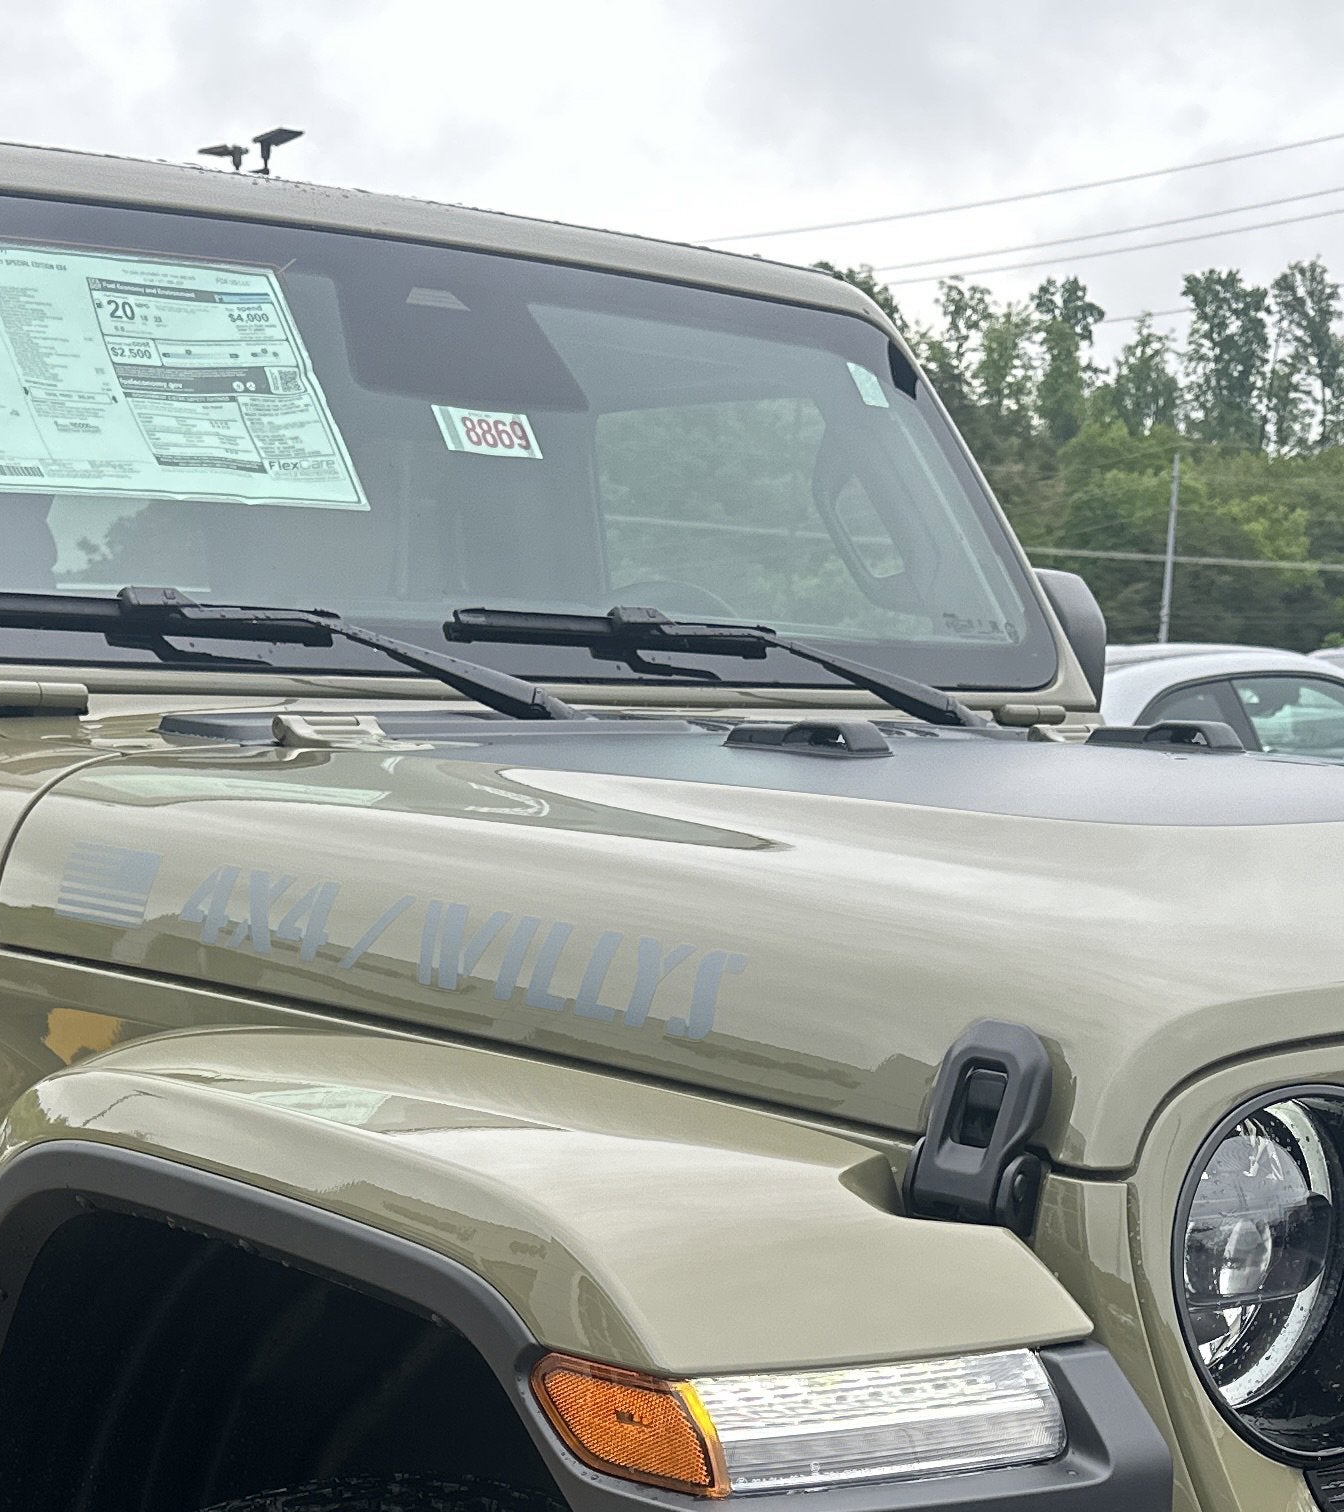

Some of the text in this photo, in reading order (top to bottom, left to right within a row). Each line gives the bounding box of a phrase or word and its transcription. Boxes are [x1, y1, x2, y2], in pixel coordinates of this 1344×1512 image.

[107, 299, 136, 321] 20
[228, 312, 269, 323] $4,000
[110, 346, 152, 360] $2,500
[461, 416, 532, 451] 8869
[268, 458, 335, 471] FlexCare
